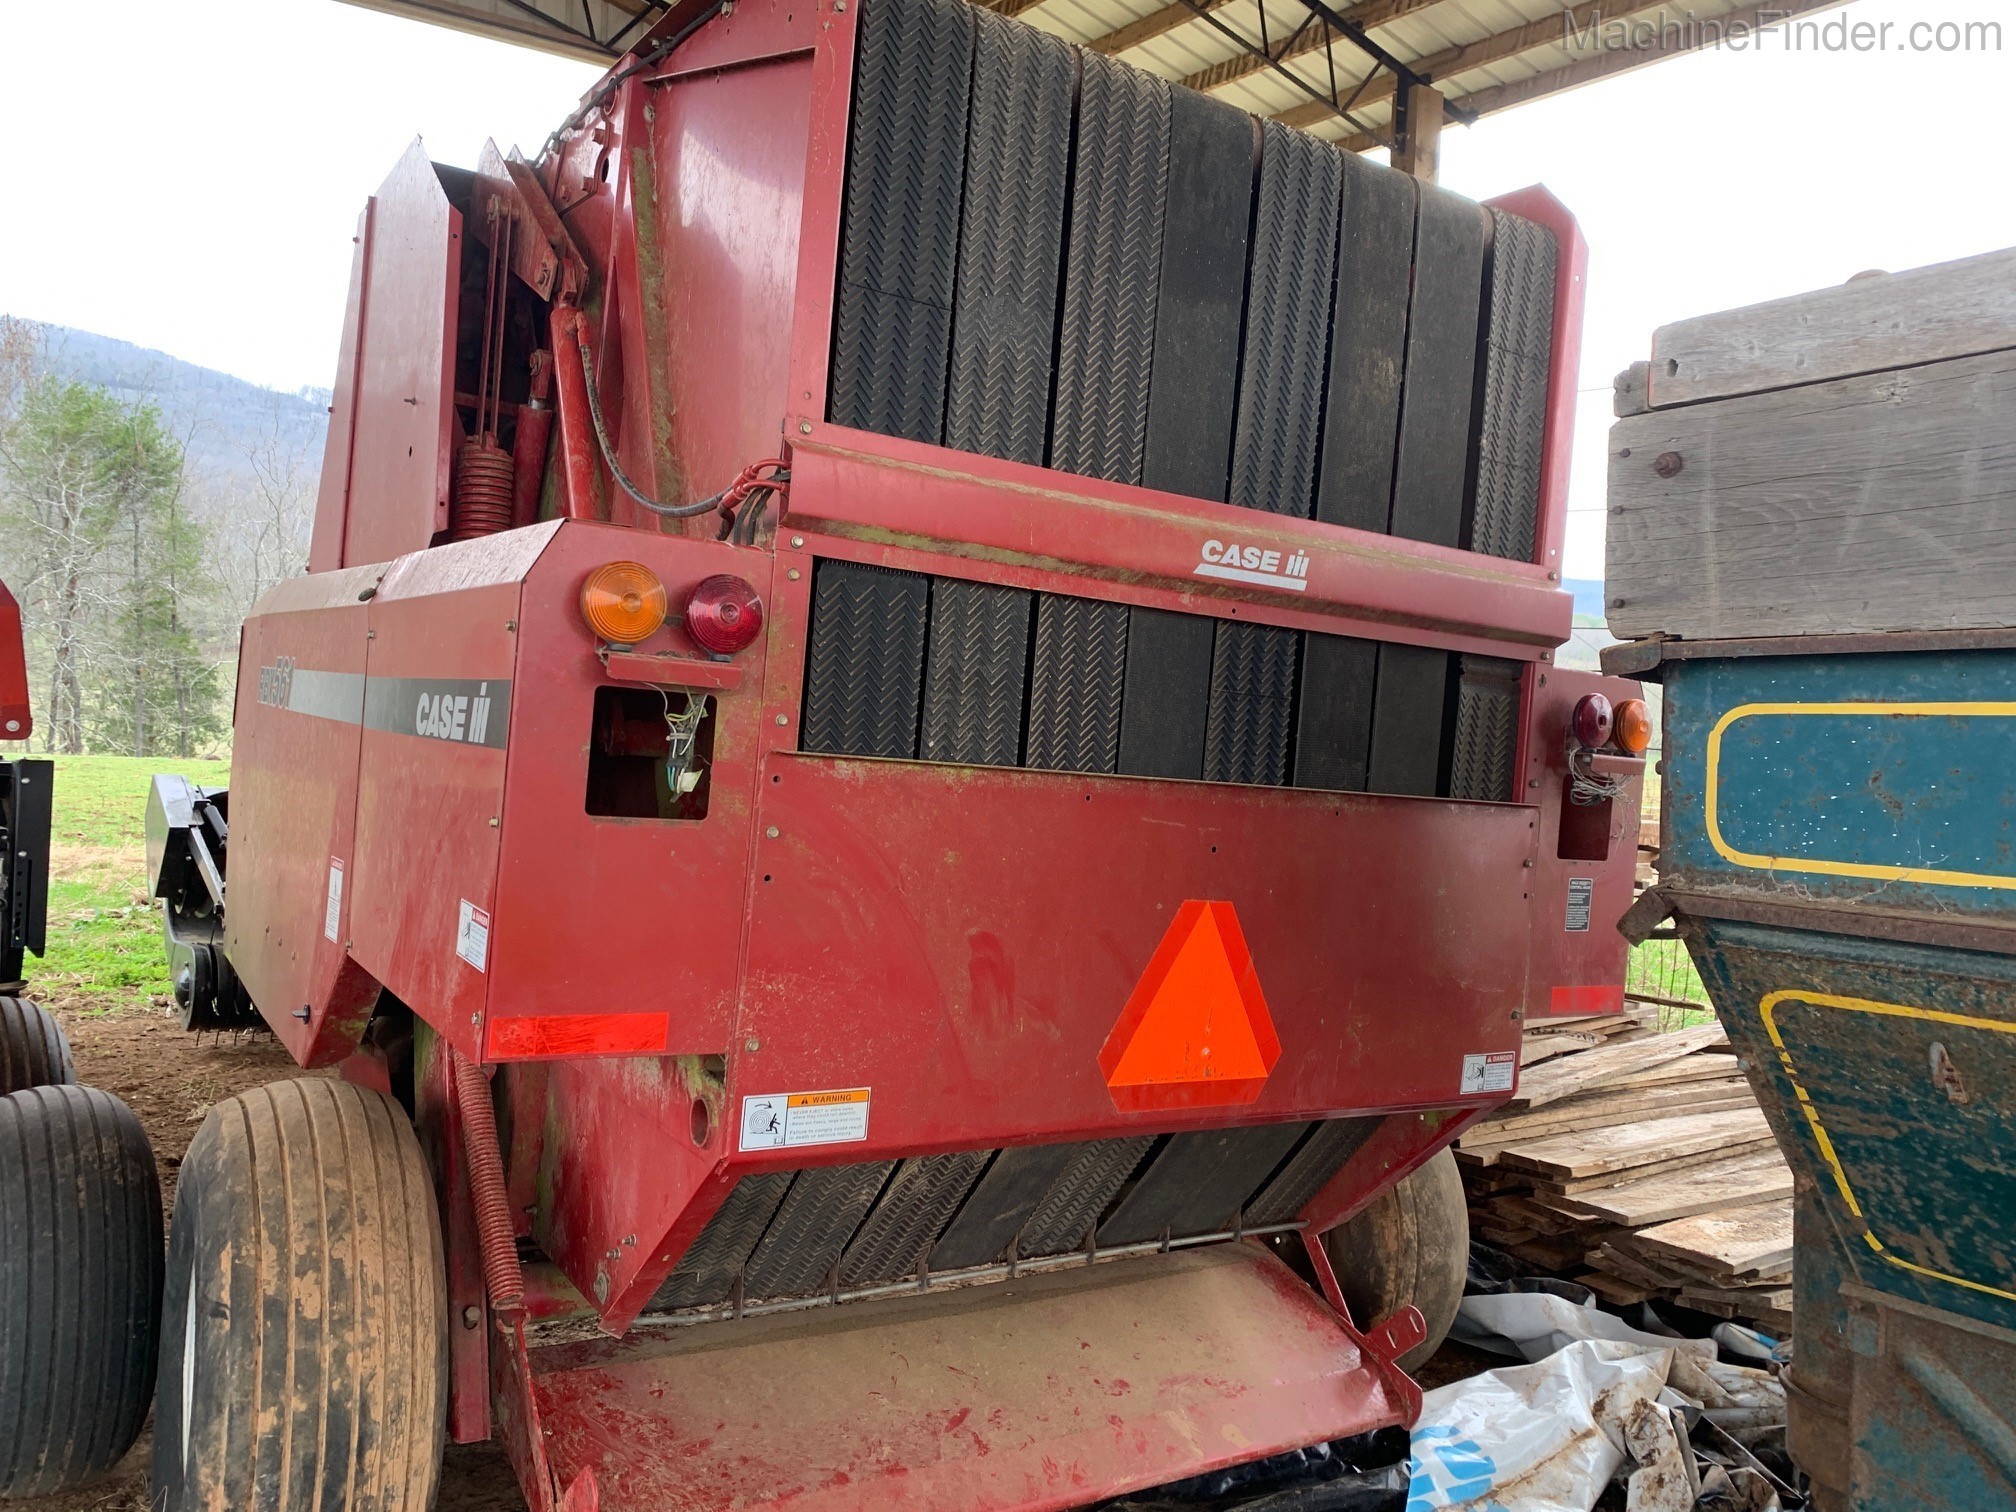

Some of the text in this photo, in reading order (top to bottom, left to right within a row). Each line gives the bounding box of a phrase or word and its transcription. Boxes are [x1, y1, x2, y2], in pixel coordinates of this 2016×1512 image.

[1201, 539, 1282, 573] CASE
[416, 692, 468, 741] CASE
[812, 1094, 851, 1103] WARNING
